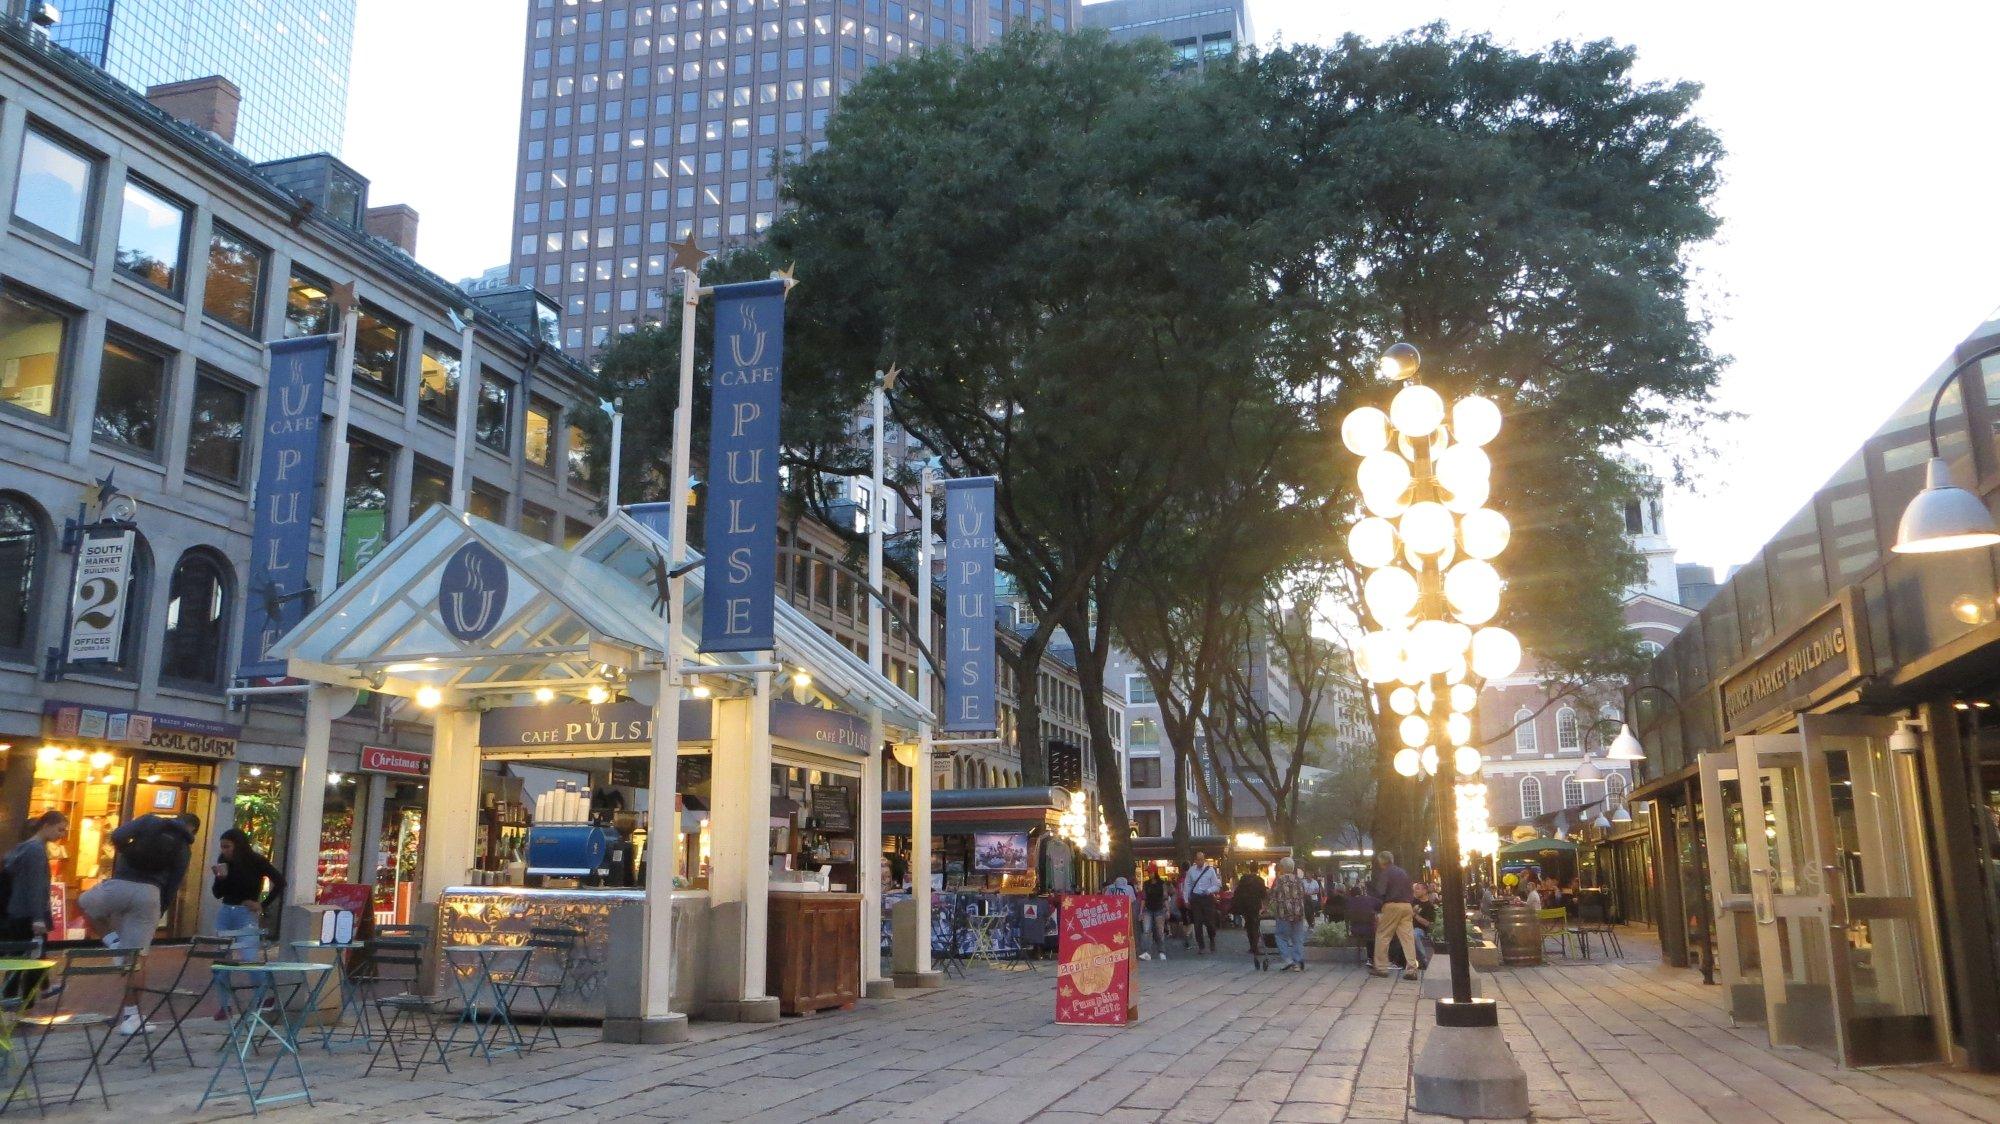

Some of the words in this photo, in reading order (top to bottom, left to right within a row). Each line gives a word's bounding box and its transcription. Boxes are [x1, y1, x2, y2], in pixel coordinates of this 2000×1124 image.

[725, 402, 763, 636] PULSE
[87, 545, 123, 556] SOUTH
[85, 556, 122, 565] MARKET
[84, 566, 120, 575] BUILDING
[74, 576, 119, 630] 2
[74, 637, 111, 646] OFFICES
[959, 561, 984, 721] PULSE
[1751, 661, 1788, 703] MARKET
[1788, 627, 1846, 680] BUILDING
[146, 731, 186, 751] OCAL
[371, 752, 420, 769] Christmas
